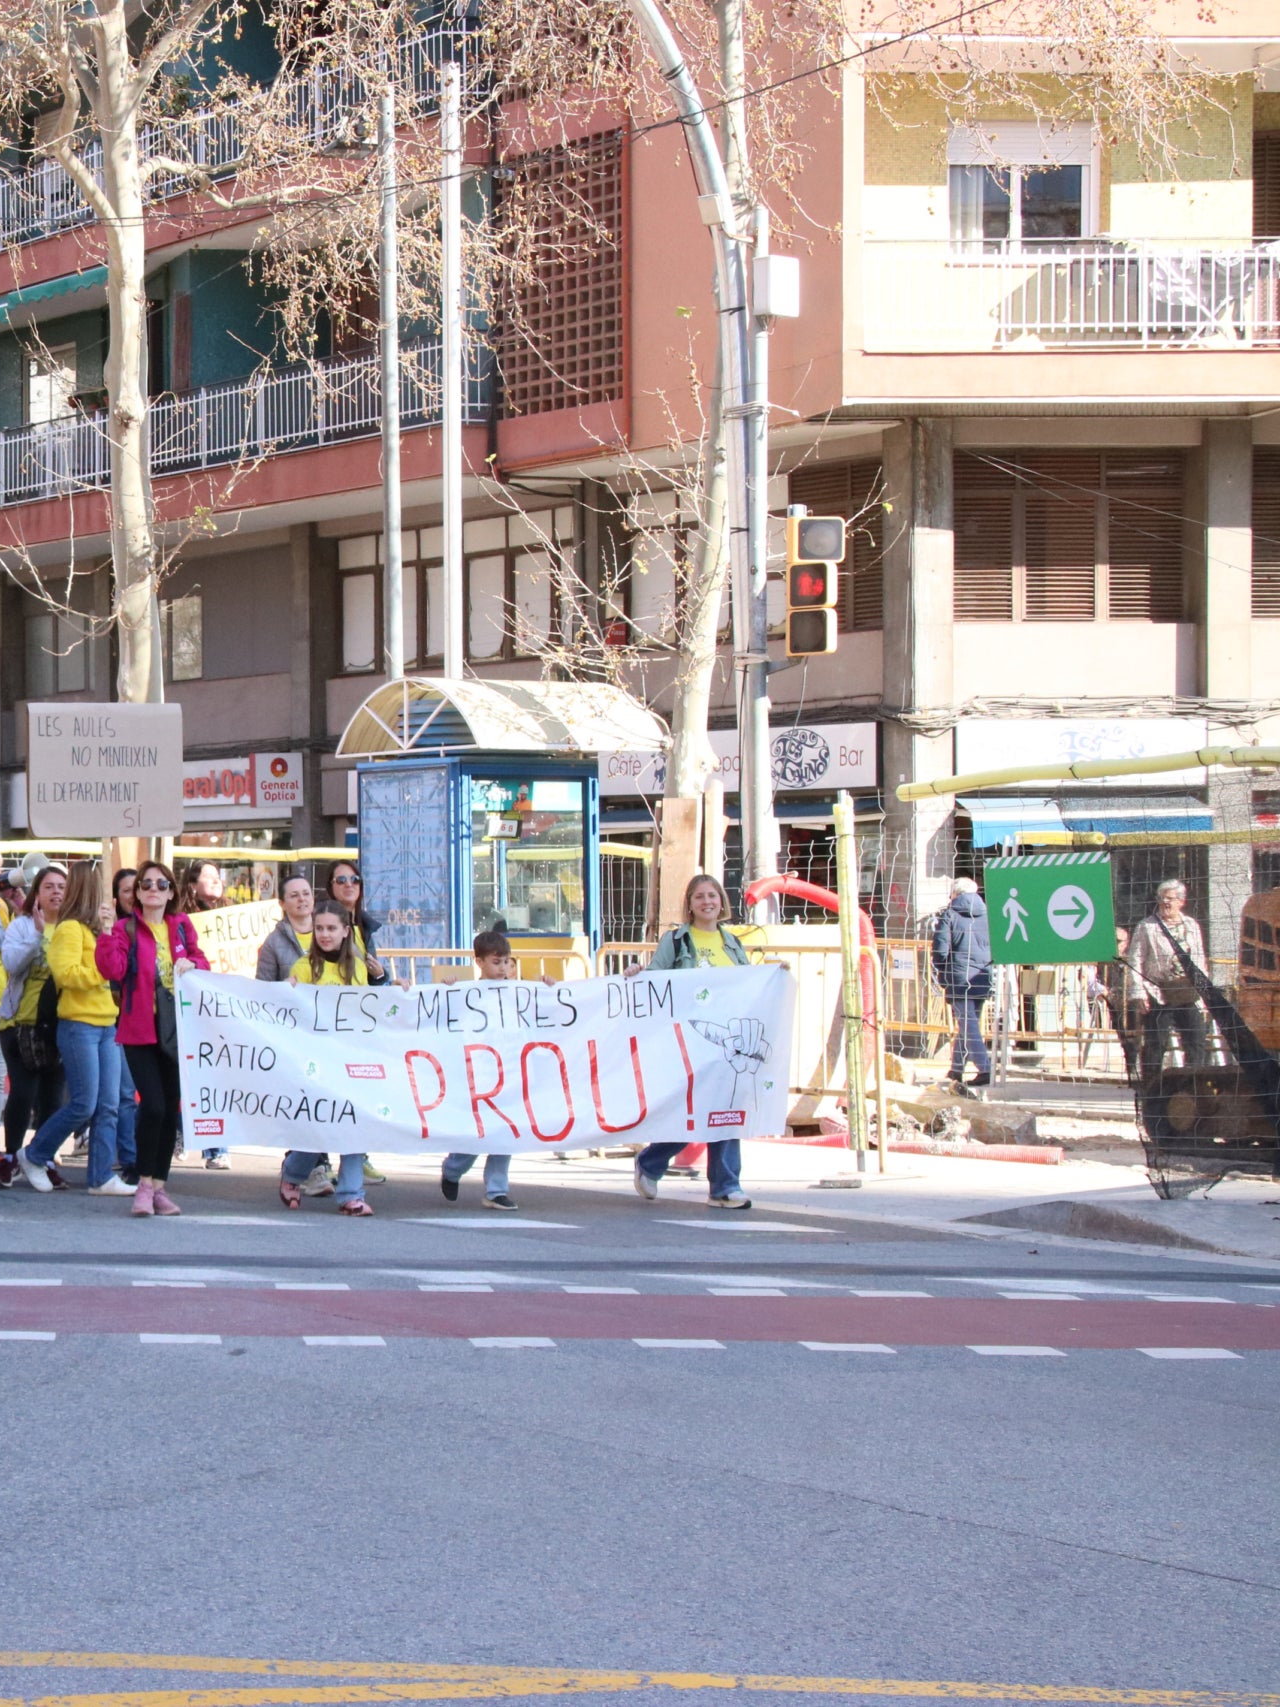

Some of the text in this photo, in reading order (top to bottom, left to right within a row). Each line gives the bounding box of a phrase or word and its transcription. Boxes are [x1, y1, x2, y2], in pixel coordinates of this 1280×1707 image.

[37, 715, 117, 738] LES AULES
[71, 745, 92, 767] NO
[839, 745, 864, 767] Bar
[37, 781, 140, 803] EL DEPARTAMENT
[182, 769, 218, 799] eral
[260, 780, 299, 790] General
[264, 791, 296, 803] Optica
[387, 908, 421, 926] ONCE
[313, 990, 380, 1033] LES
[416, 985, 578, 1034] MESTRES
